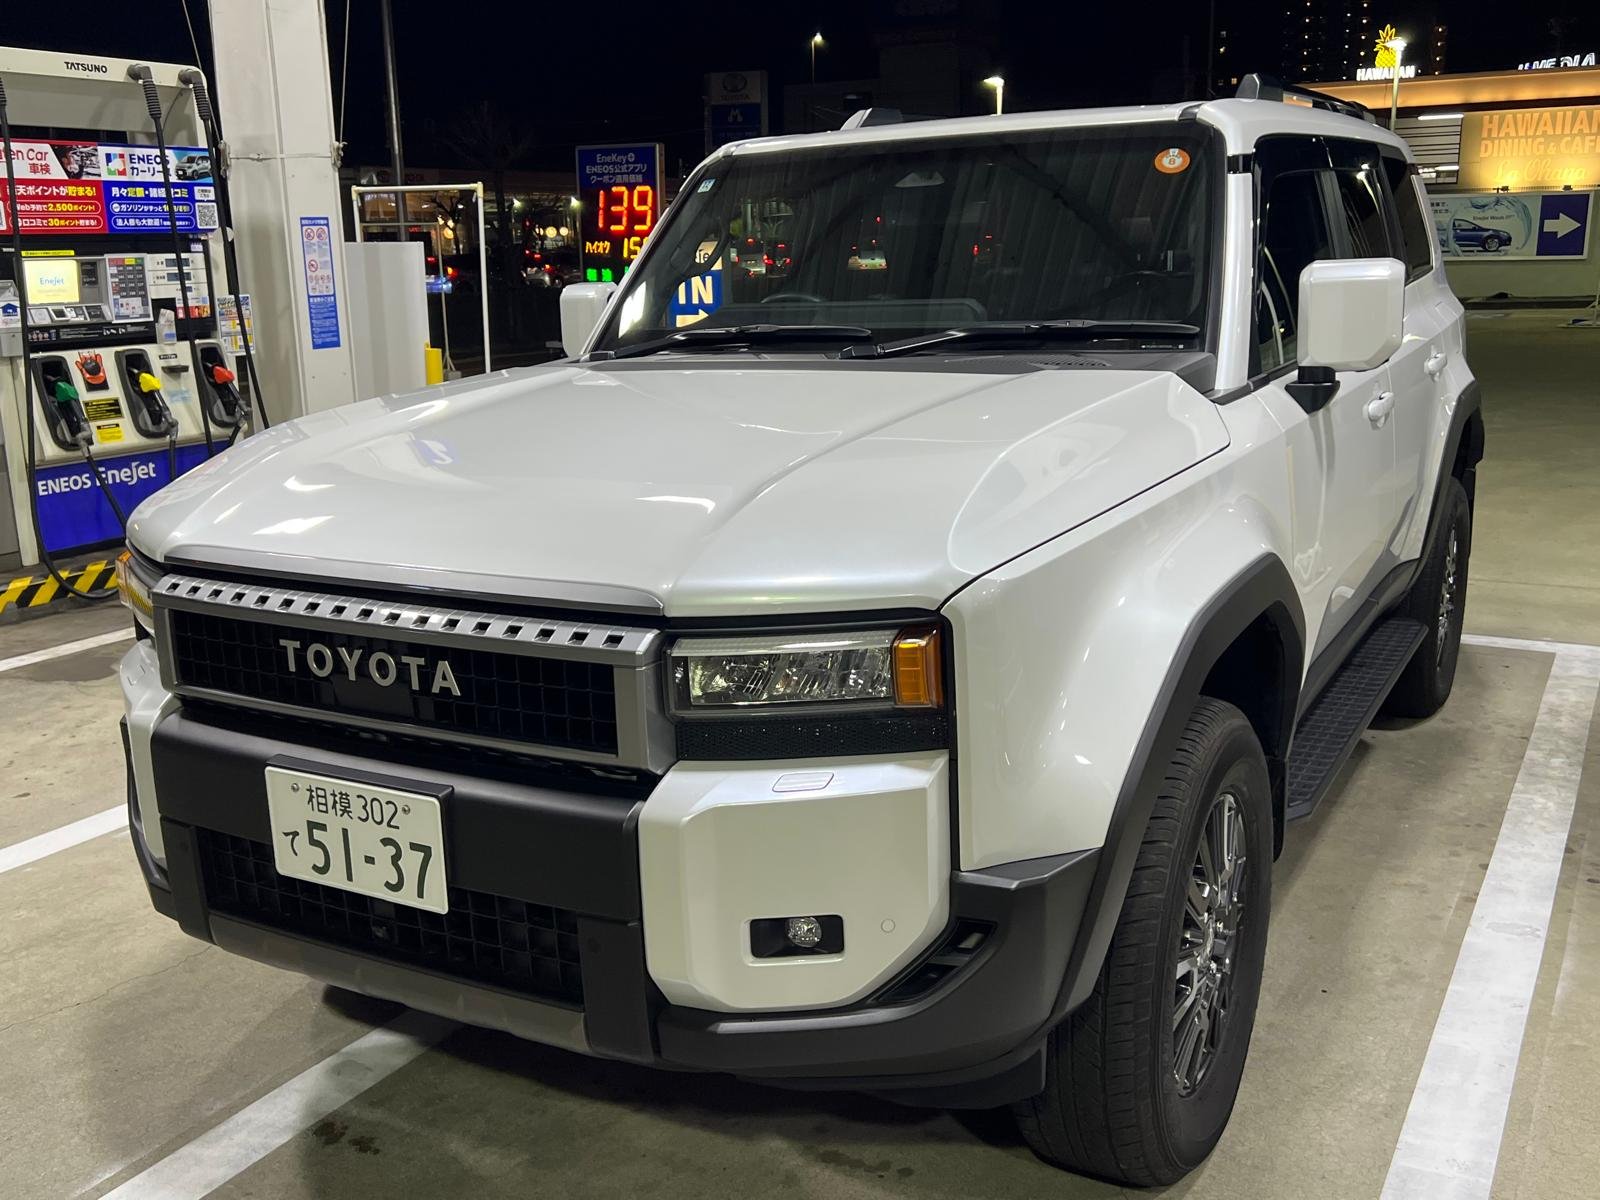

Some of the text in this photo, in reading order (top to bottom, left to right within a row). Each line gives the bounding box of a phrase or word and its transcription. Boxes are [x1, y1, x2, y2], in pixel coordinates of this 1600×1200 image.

[64, 61, 108, 73] TATSUNO
[1356, 65, 1416, 81] HAWAIAN
[26, 148, 49, 161] Car
[1480, 138, 1545, 157] DINING
[1547, 142, 1558, 153] &
[596, 153, 627, 164] EneKey
[28, 162, 51, 175] 車検
[586, 164, 647, 174] ENEOS公式アプリ
[598, 186, 653, 231] 139
[585, 241, 611, 254] ハイオク
[678, 275, 713, 305] IN
[37, 473, 92, 496] ENEOS
[279, 639, 461, 696] TOYOTA
[306, 785, 400, 830] 相模 302
[282, 819, 433, 900] て 51-37
